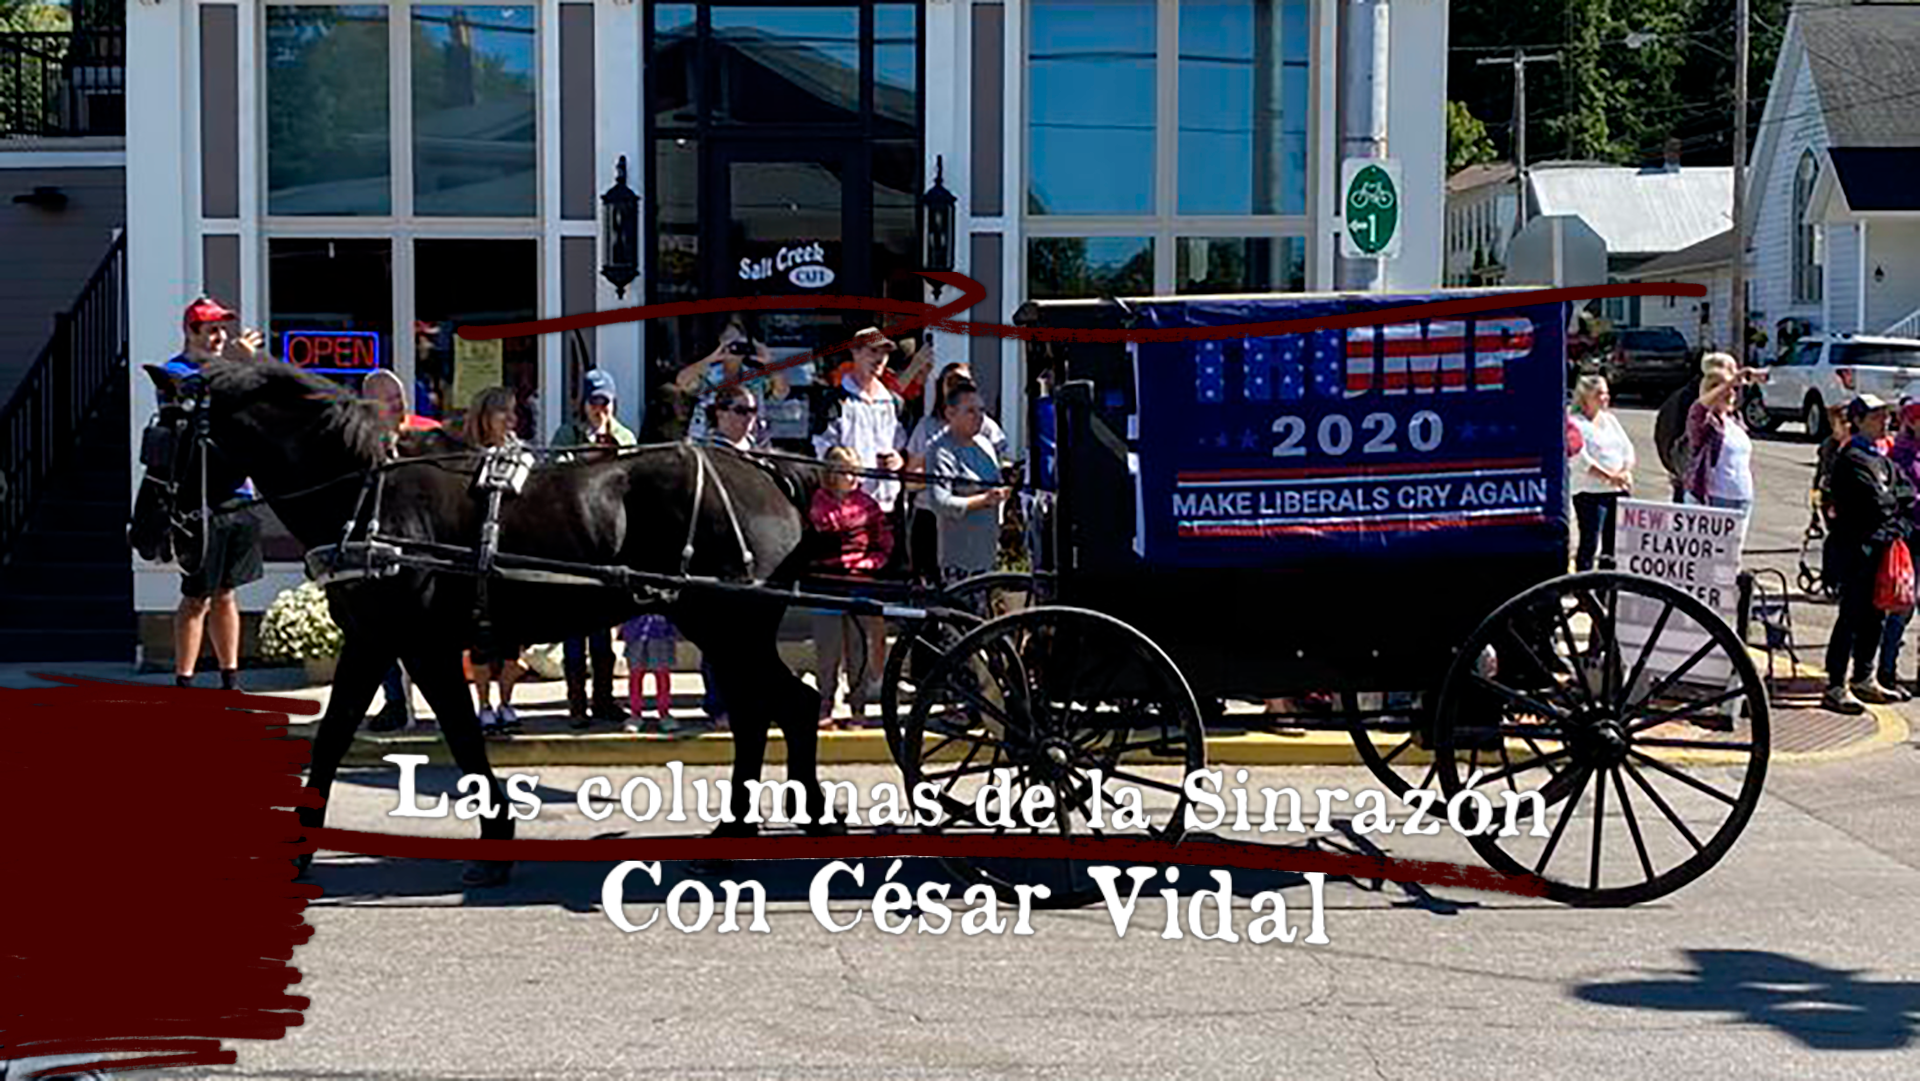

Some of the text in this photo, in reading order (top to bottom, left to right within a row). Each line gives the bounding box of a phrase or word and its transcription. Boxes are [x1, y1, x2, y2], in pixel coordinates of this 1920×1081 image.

[1367, 213, 1377, 242] 1
[776, 241, 825, 271] Creek
[289, 336, 375, 367] OPEN
[1193, 317, 1533, 401] TRUMP
[1271, 409, 1444, 457] 2020
[1172, 478, 1547, 516] MAKE LIBERALS CRY AGAIN
[1623, 508, 1735, 536] NEW SYRUP
[1641, 532, 1724, 558] FLAVOR-
[1630, 555, 1696, 581] COOKIE
